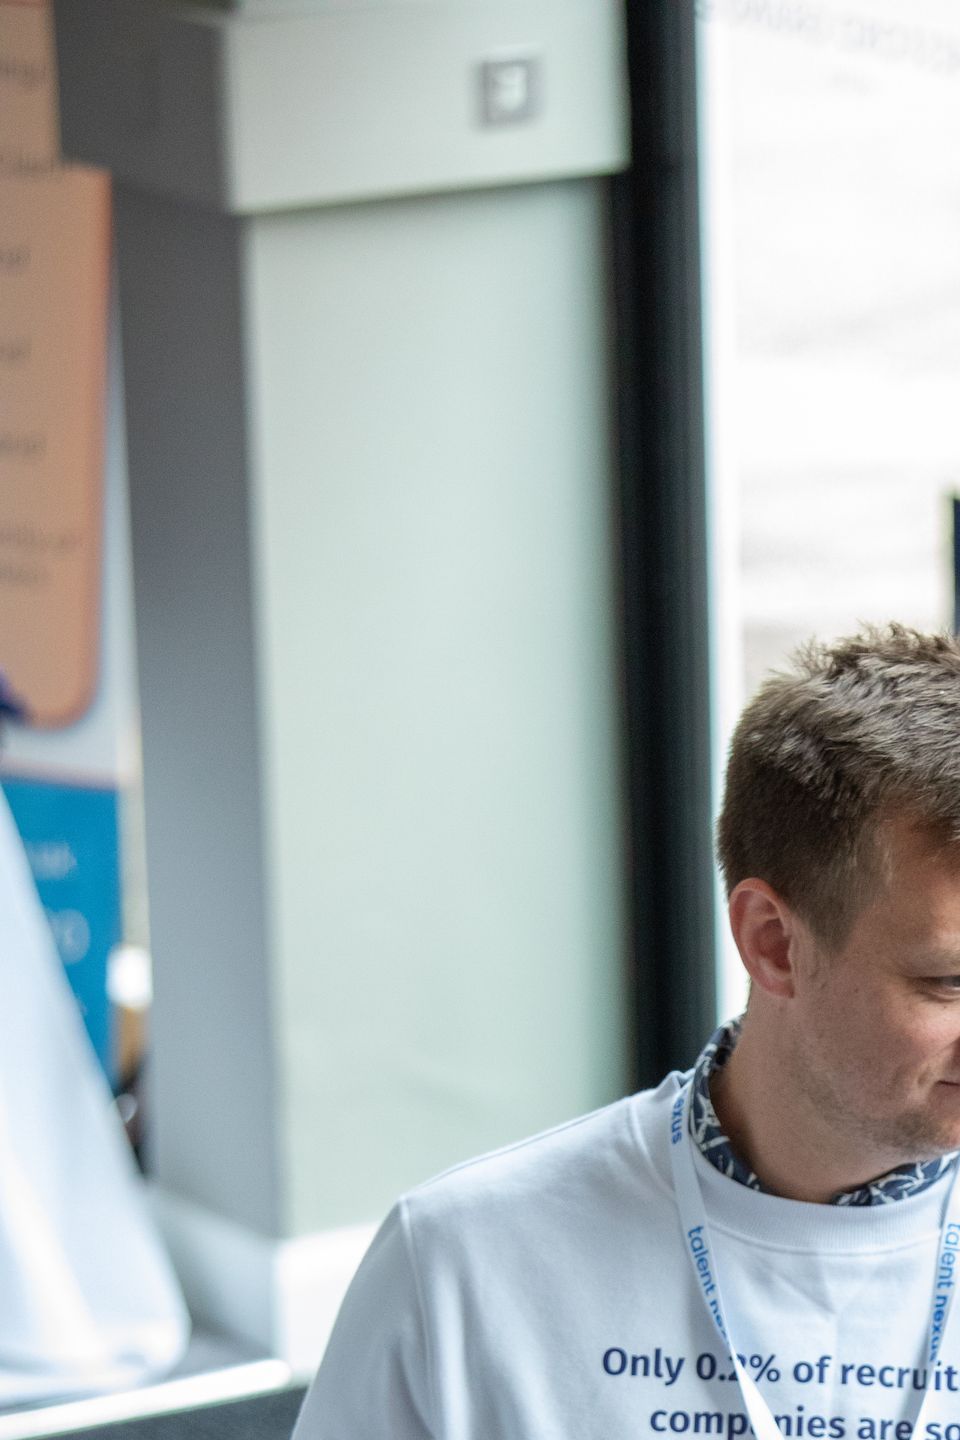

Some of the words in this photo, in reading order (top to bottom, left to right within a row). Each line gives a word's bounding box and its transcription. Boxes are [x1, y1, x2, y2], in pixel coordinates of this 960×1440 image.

[672, 1097, 685, 1145] exus
[688, 1225, 717, 1296] talent
[602, 1347, 686, 1387] Only
[793, 1355, 832, 1385] of
